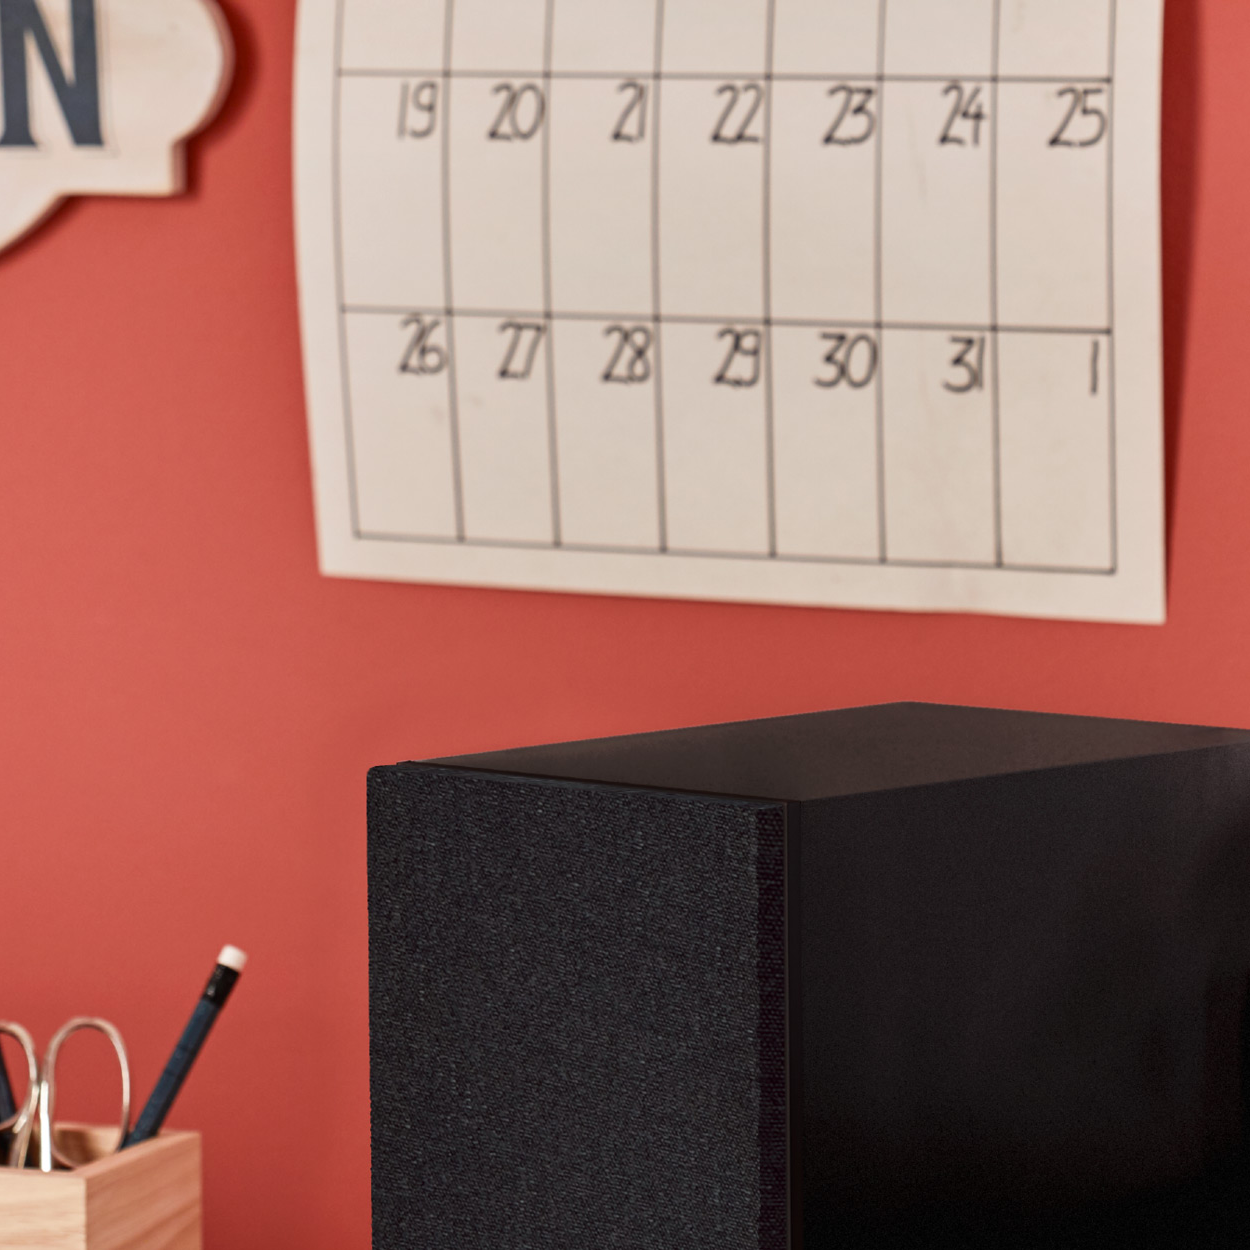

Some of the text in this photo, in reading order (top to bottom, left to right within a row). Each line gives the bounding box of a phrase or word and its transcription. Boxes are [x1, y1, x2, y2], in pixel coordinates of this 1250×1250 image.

[397, 80, 1107, 147] 19 20 21 22 23 24 25
[399, 315, 1099, 395] 26 27 28 29 30 31 1
